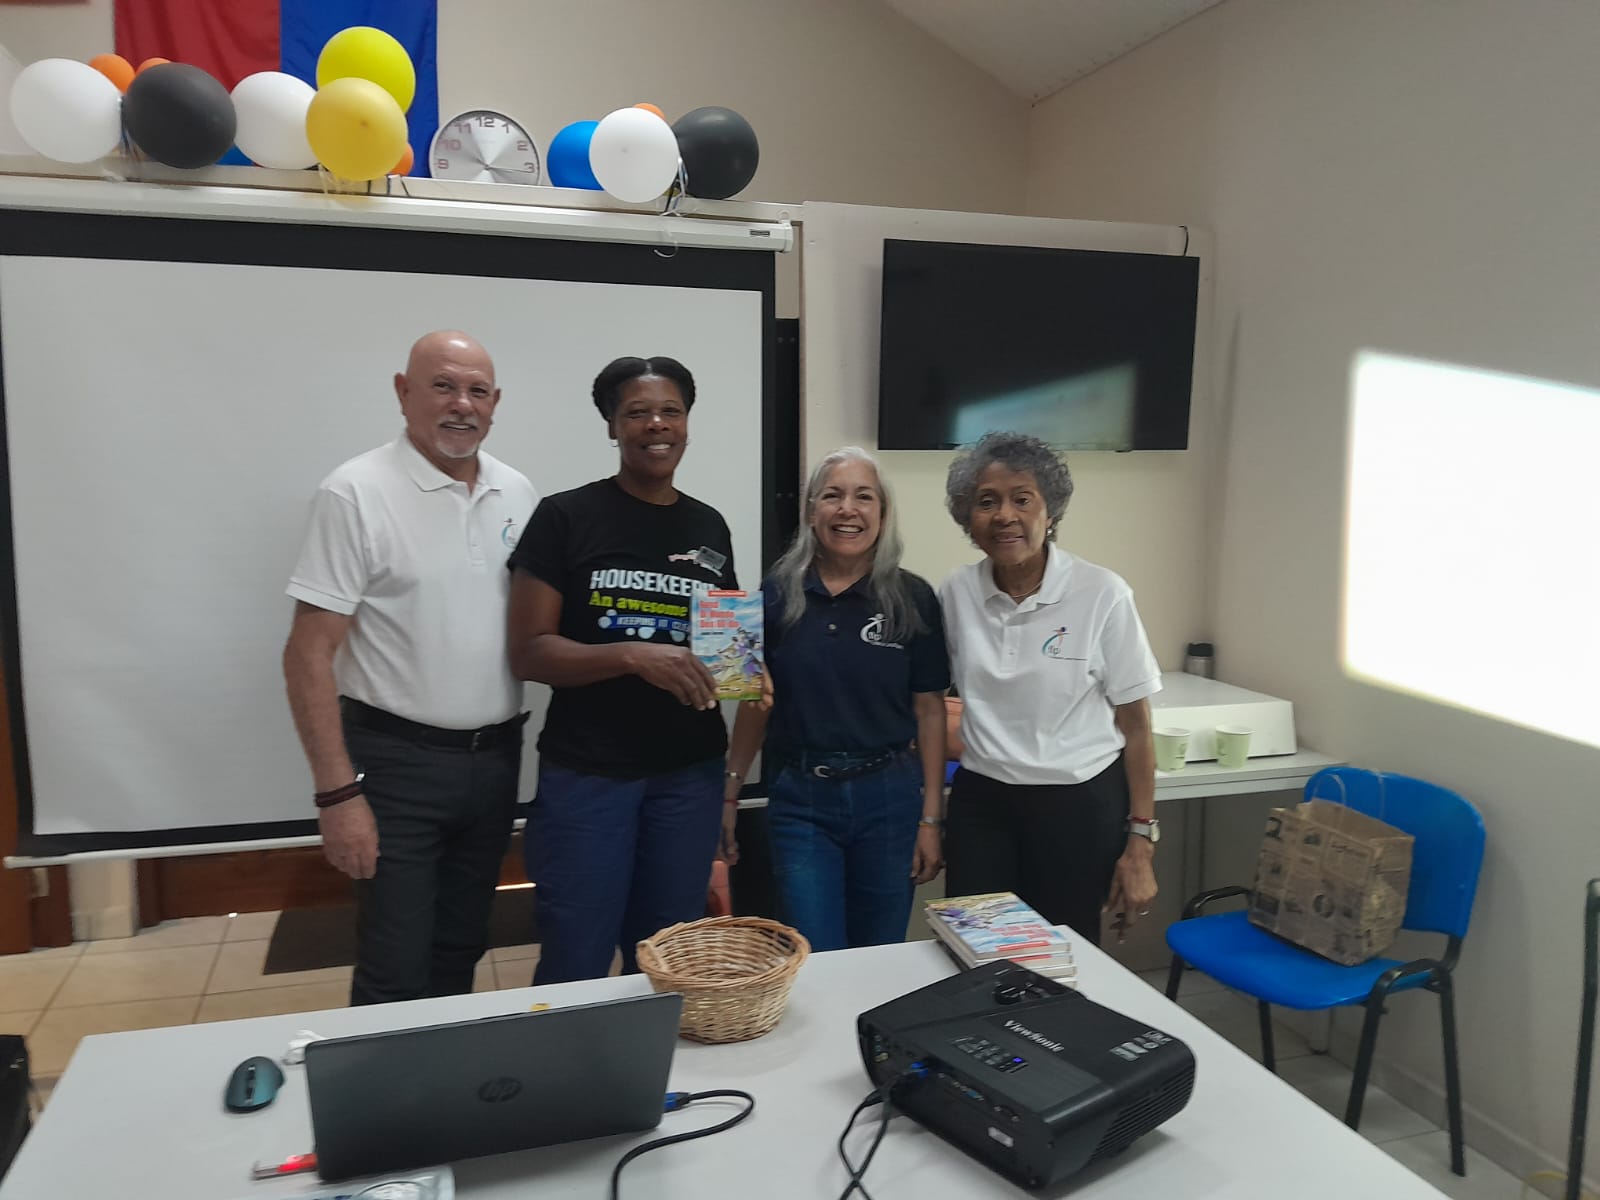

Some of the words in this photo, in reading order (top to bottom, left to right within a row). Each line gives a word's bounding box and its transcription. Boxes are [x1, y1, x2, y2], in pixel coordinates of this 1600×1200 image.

[454, 122, 471, 134] 11
[475, 116, 495, 128] 12
[501, 122, 510, 134] 1
[438, 139, 461, 151] 10
[516, 140, 529, 151] 2
[437, 159, 449, 170] 9
[523, 162, 536, 174] 3
[589, 591, 613, 608] An
[616, 597, 688, 617] awesome
